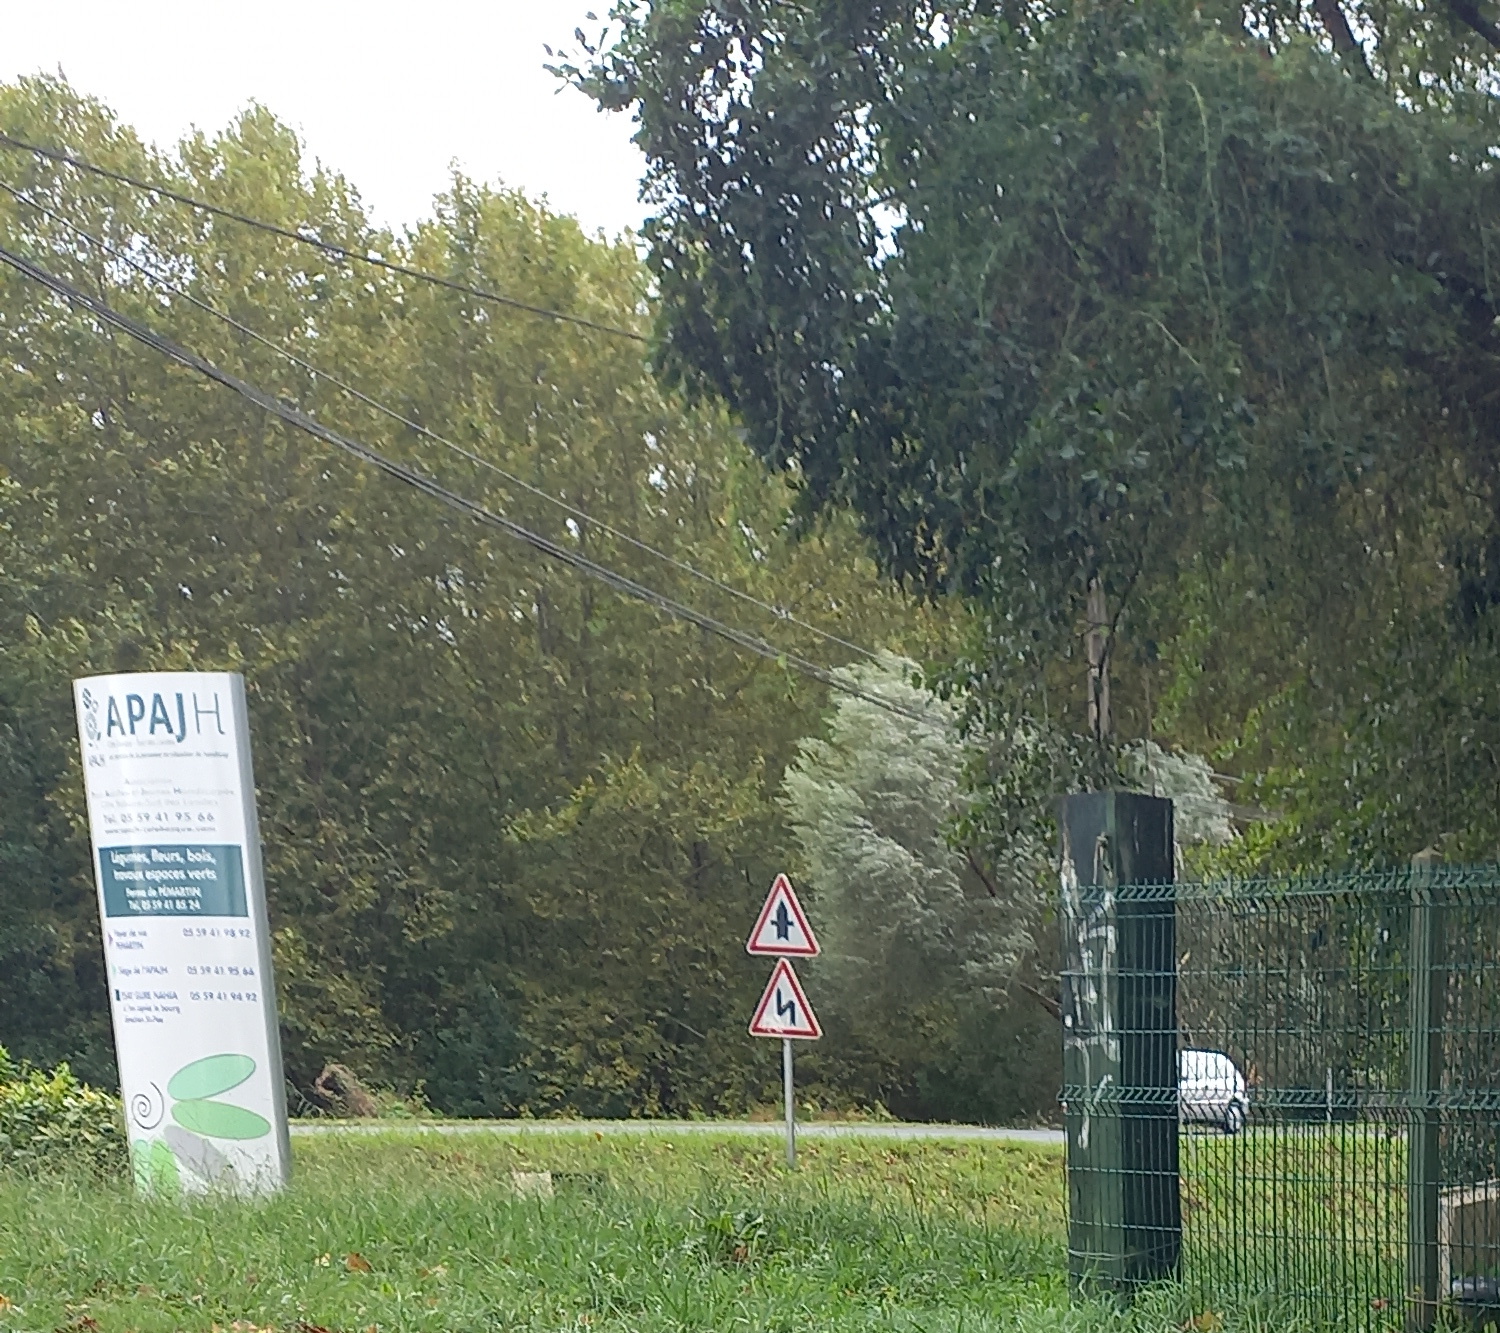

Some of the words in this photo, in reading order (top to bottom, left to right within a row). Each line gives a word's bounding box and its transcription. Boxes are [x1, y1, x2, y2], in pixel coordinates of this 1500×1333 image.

[107, 692, 226, 743] APAJH
[137, 812, 150, 822] 59
[155, 812, 169, 822] 41
[175, 811, 191, 821] 95
[197, 812, 215, 822] 66
[209, 928, 220, 937] 41
[214, 966, 224, 975] 41
[203, 992, 213, 1000] 59
[217, 992, 227, 1000] 41
[245, 992, 257, 1002] 92
